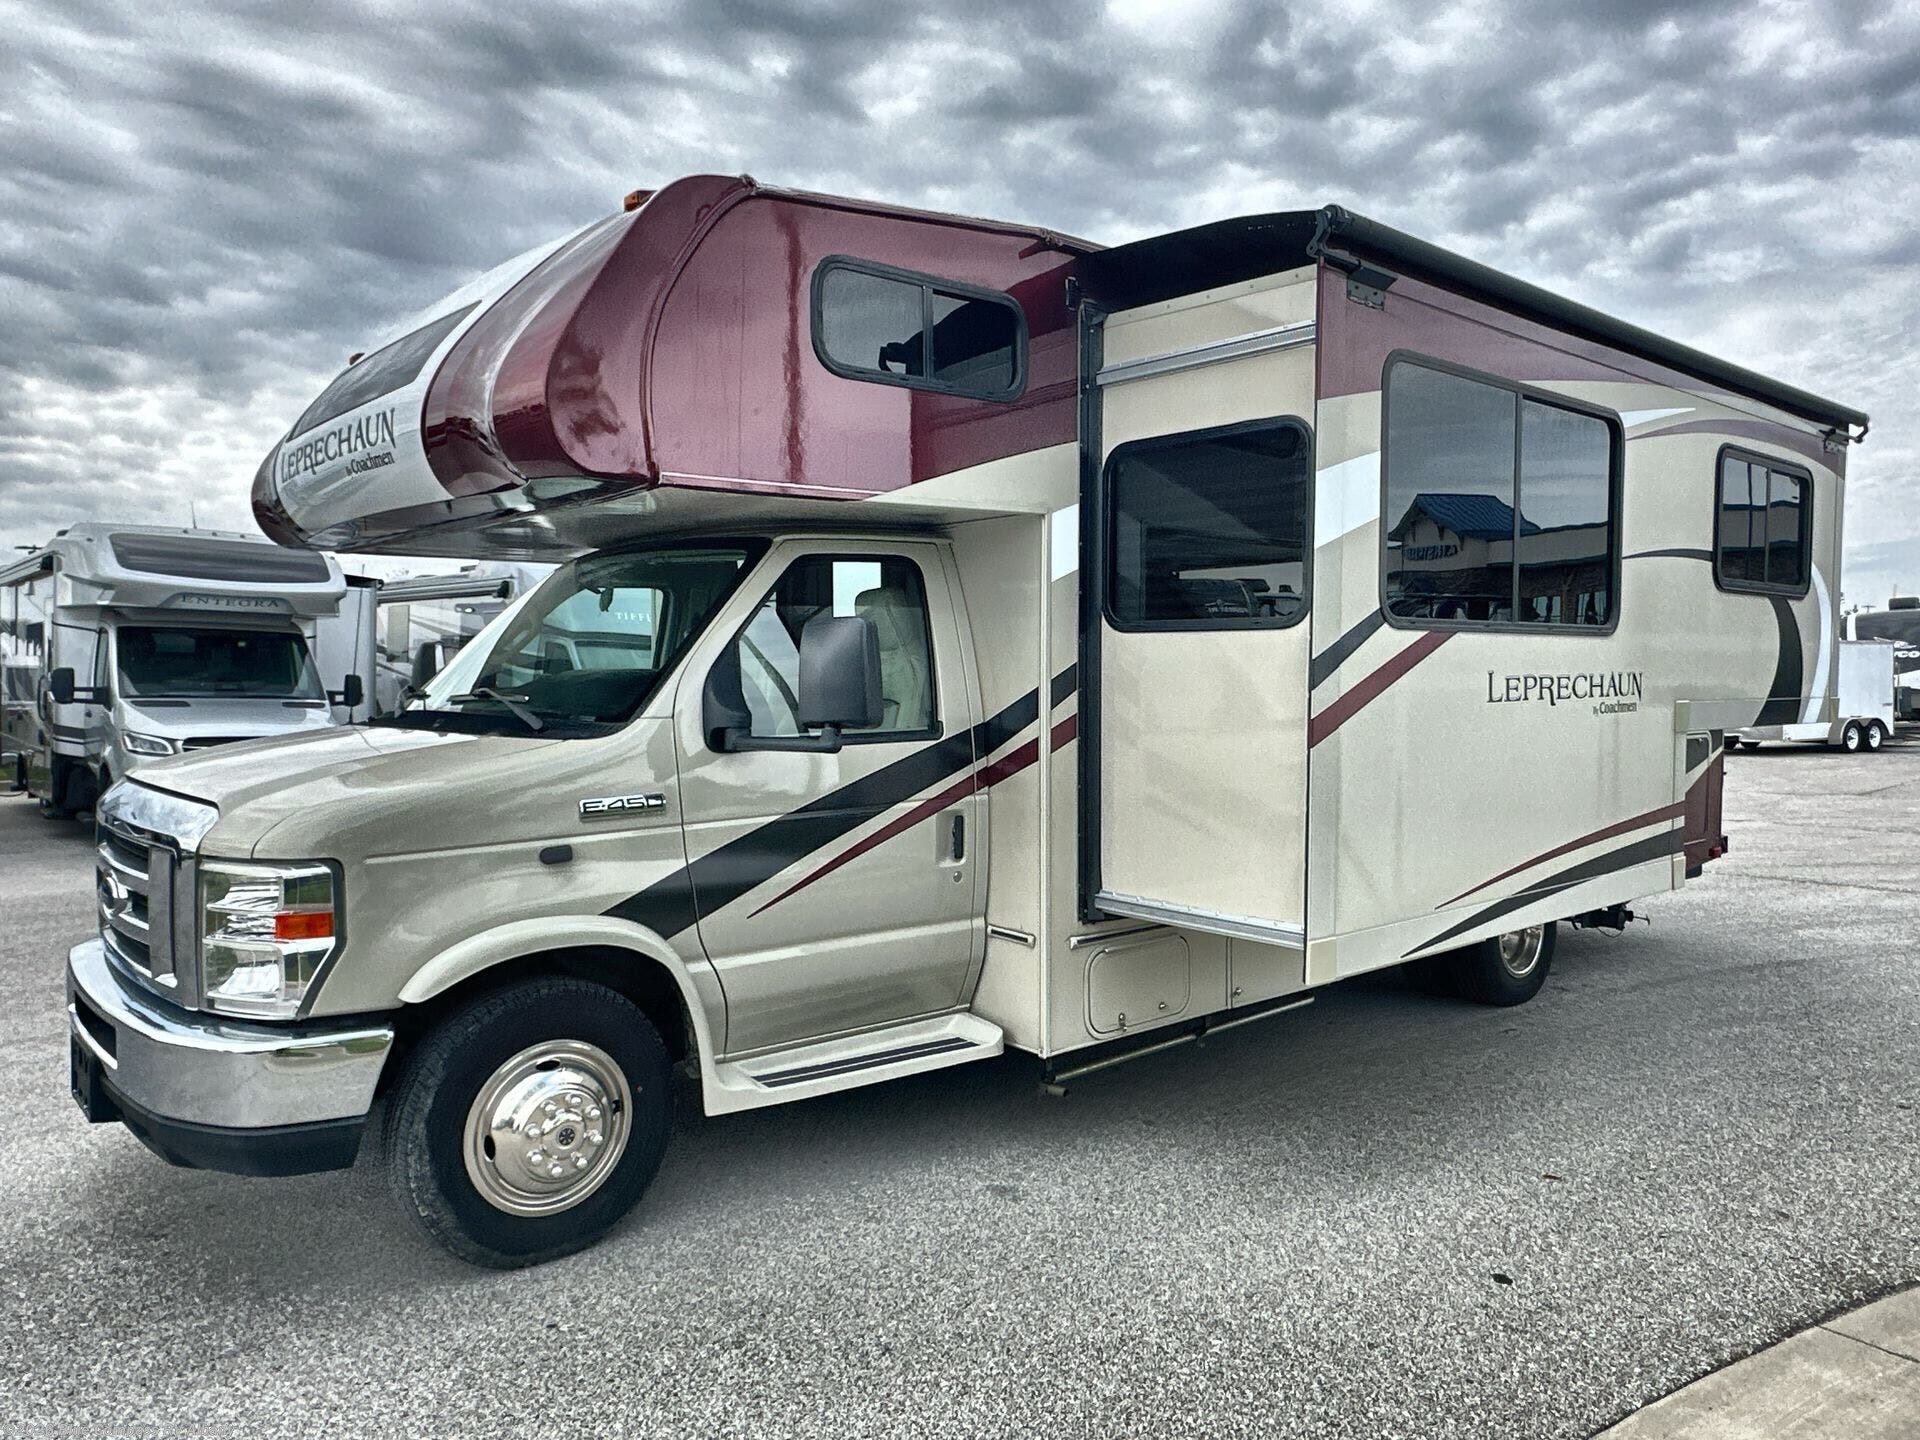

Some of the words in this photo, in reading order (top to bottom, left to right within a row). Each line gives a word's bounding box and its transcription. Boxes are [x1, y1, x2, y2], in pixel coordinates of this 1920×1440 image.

[280, 407, 397, 484] LEPRECHAUN
[350, 452, 396, 475] Coachmen
[182, 594, 279, 608] ENTEGRA
[1486, 669, 1643, 706] LEPRECHAUN
[1599, 700, 1637, 714] Coachmen
